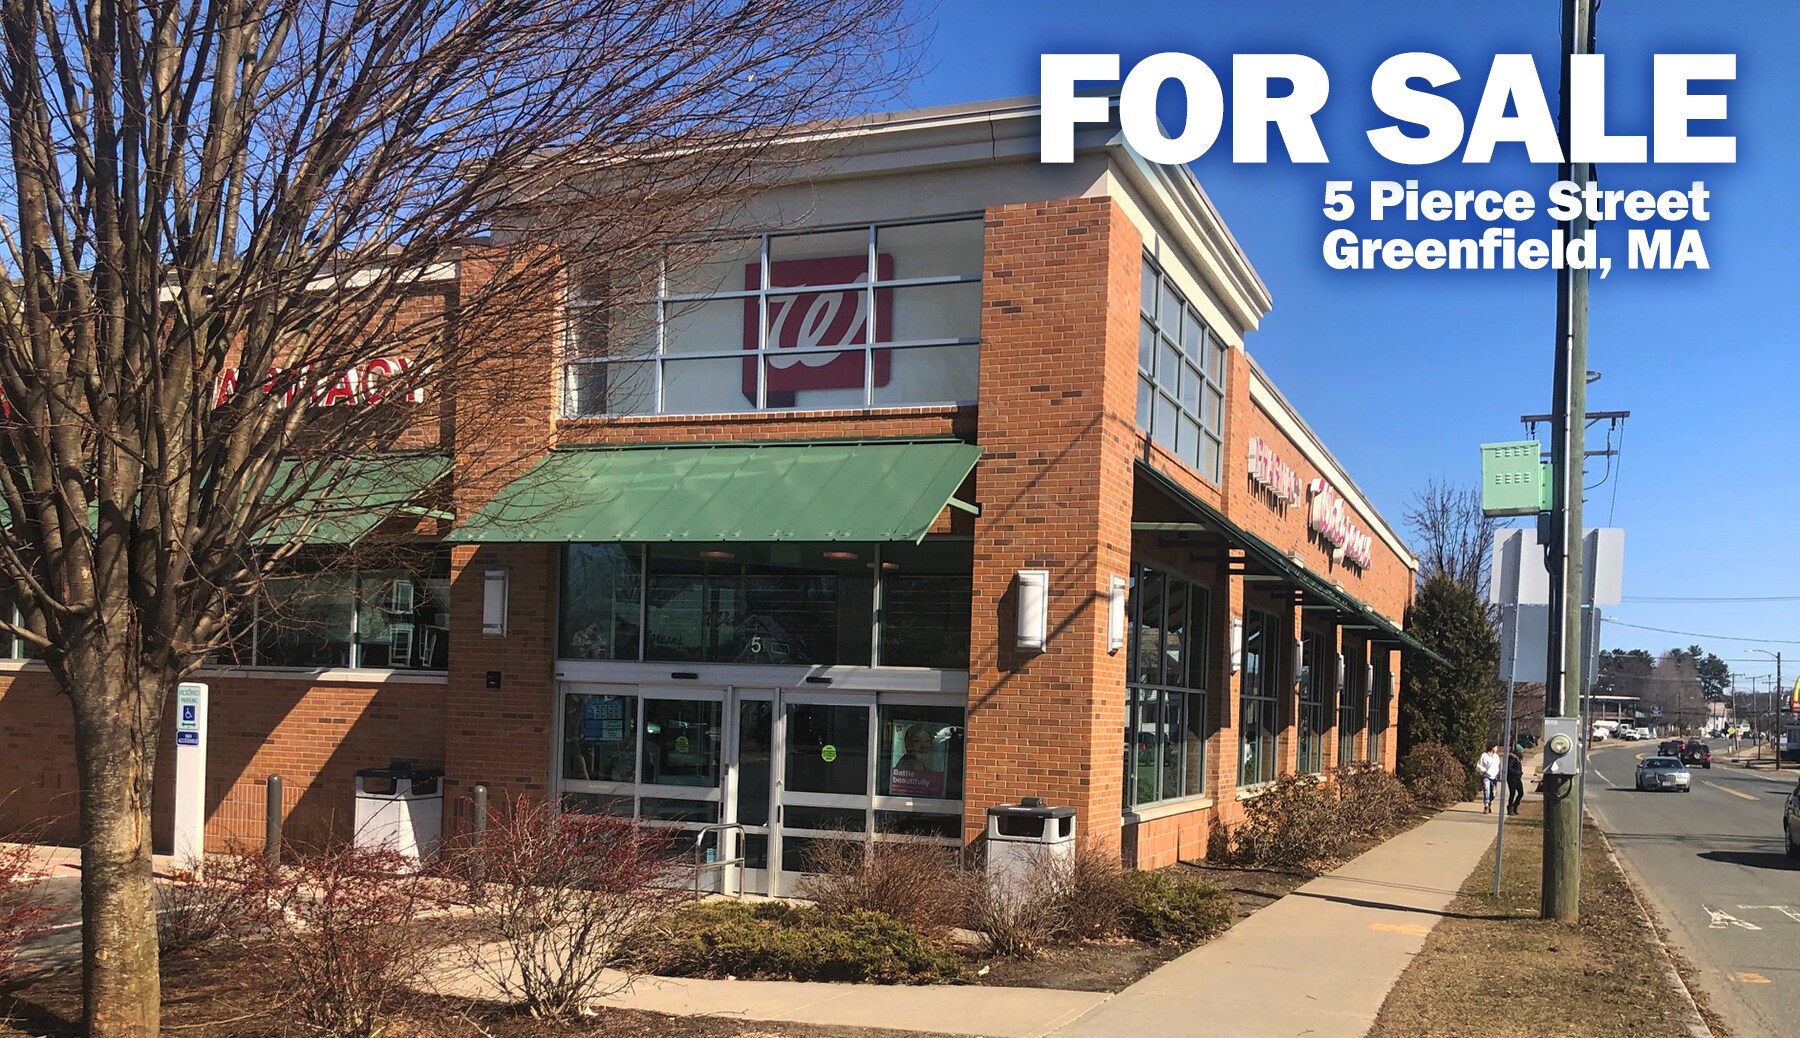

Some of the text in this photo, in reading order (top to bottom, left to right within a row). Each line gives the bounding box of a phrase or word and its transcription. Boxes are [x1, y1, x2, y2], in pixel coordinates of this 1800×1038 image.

[750, 636, 762, 653] 5
[893, 768, 915, 778] Battle
[892, 776, 931, 787] beautifully
